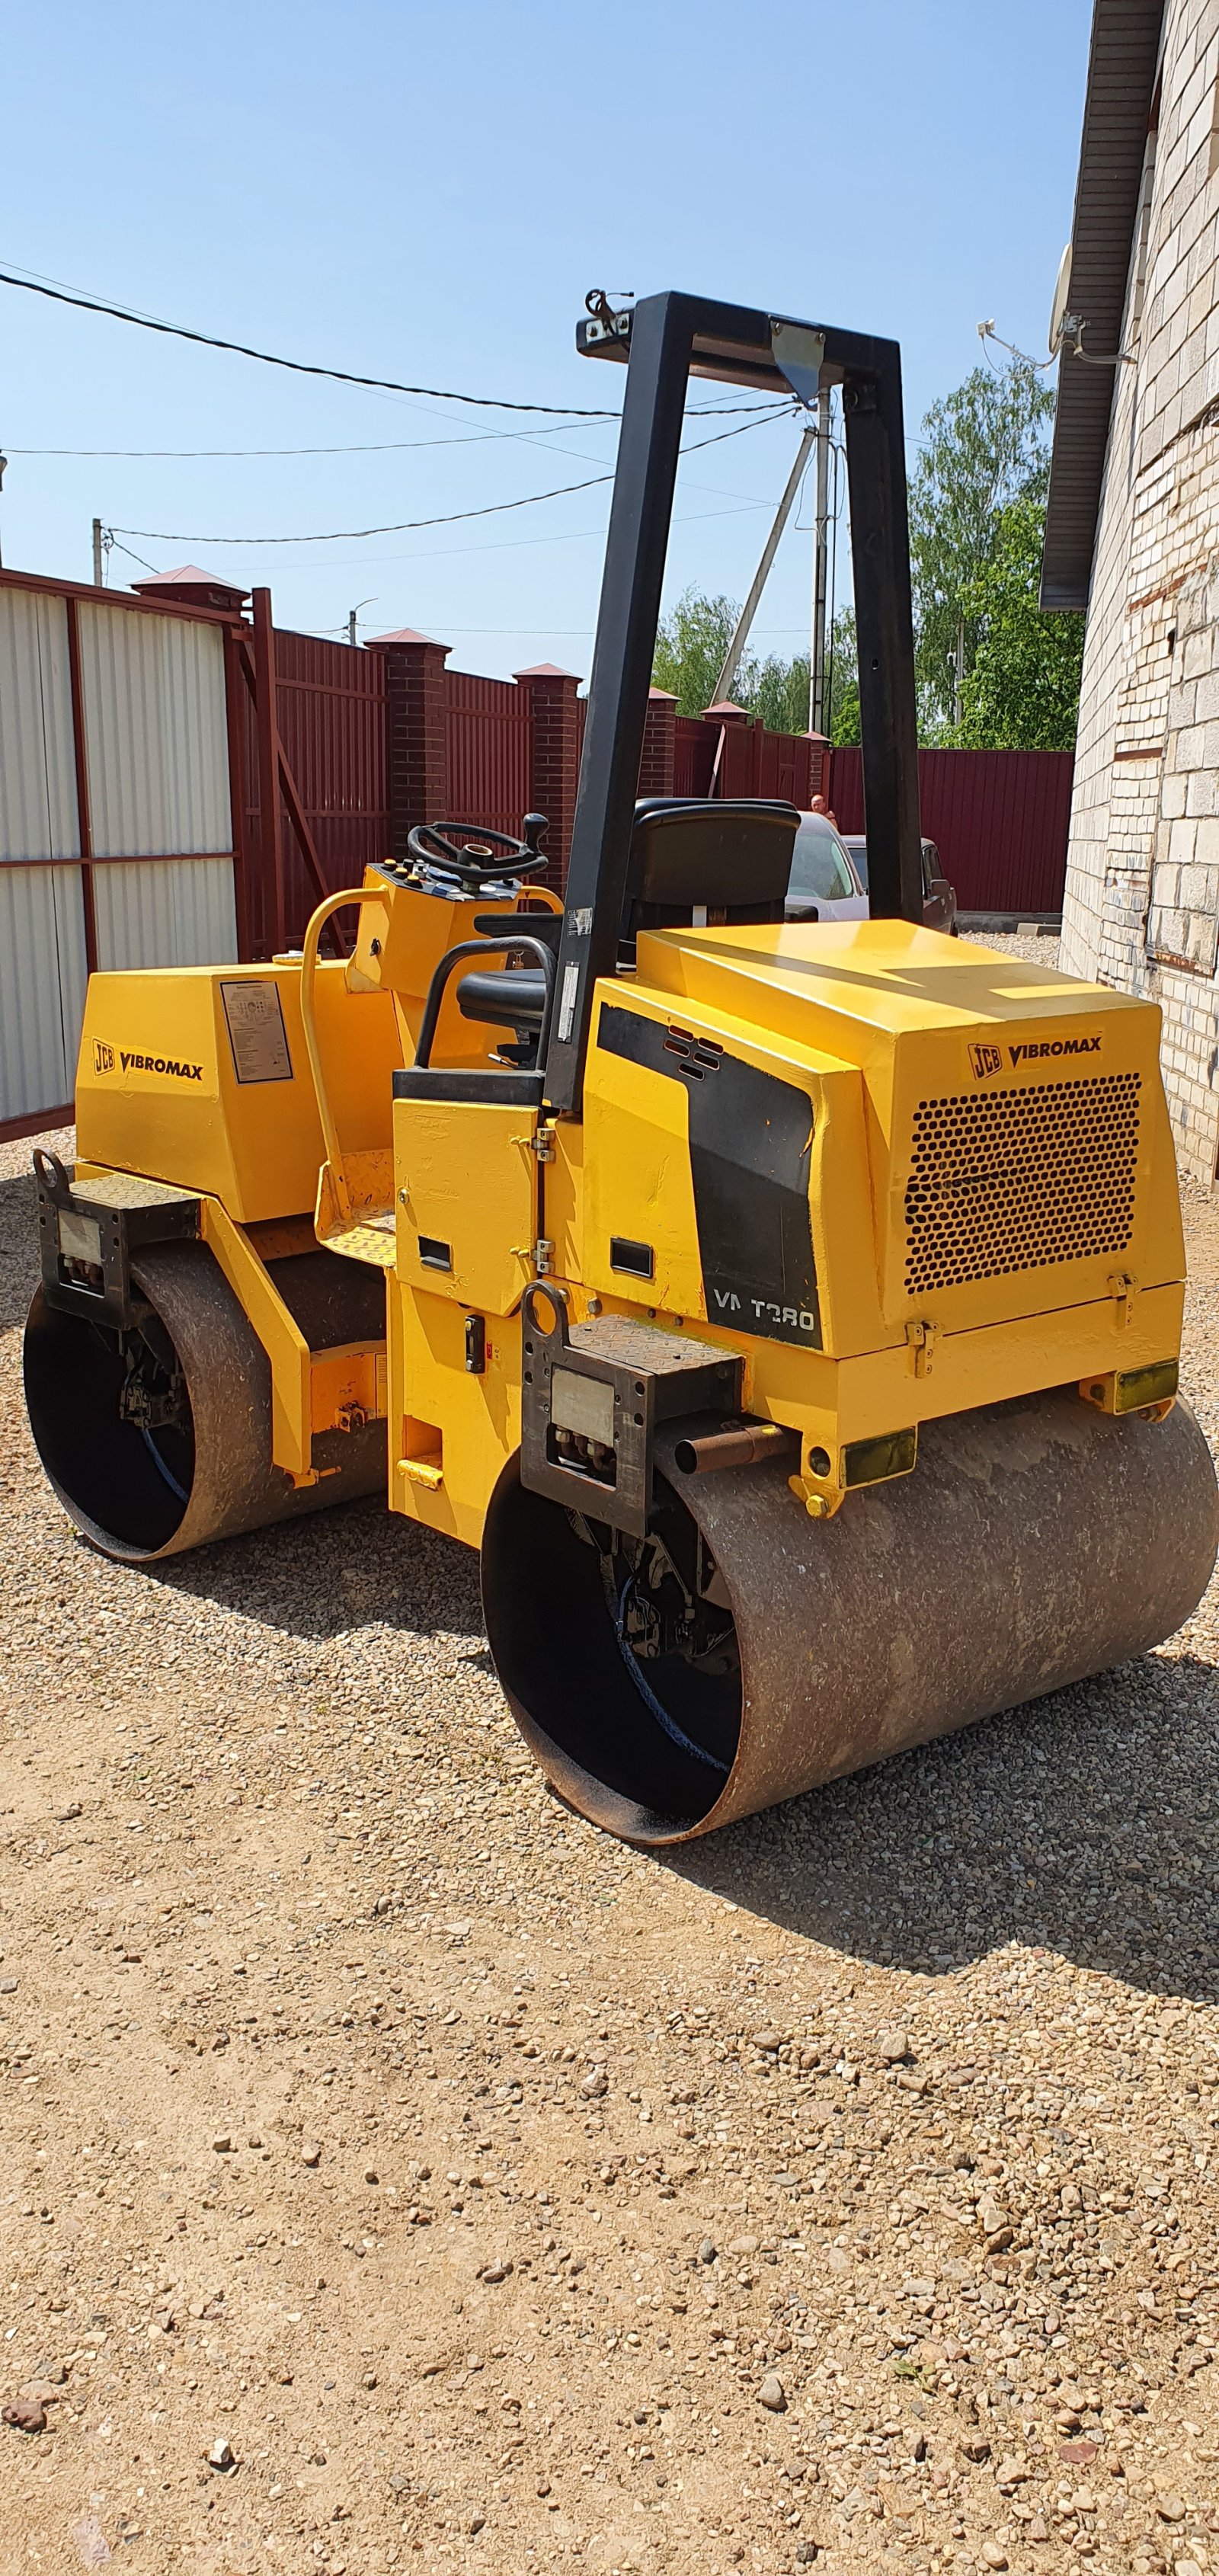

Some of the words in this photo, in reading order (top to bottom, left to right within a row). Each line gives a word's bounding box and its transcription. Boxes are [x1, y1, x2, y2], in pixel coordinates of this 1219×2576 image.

[94, 1044, 114, 1073] JCB
[120, 1052, 204, 1080] VIBROMAX
[974, 1045, 1000, 1079] JCB
[1008, 1037, 1102, 1068] VIBROMAX
